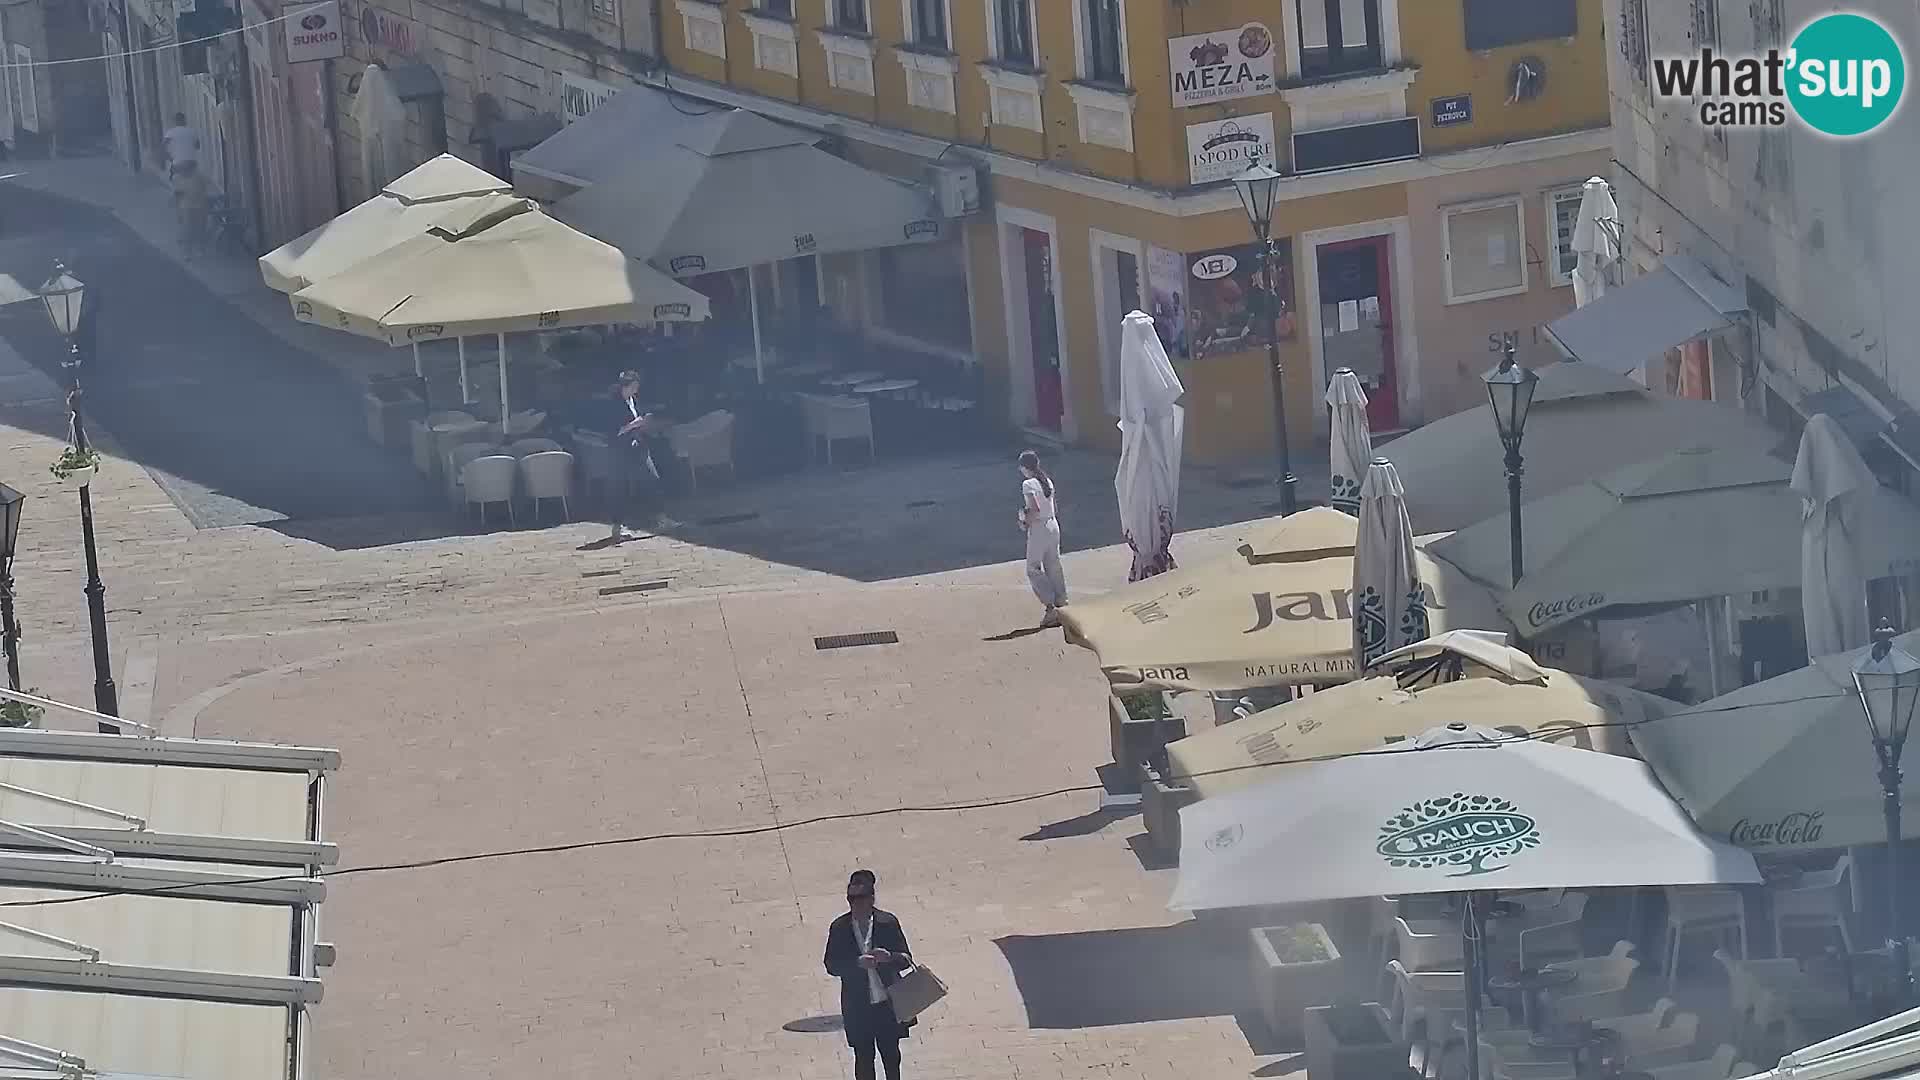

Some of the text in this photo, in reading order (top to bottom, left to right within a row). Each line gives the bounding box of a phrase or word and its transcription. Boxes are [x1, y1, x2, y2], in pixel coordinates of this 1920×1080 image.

[293, 31, 338, 46] SUKNO
[1175, 62, 1254, 93] MEZA
[1184, 89, 1217, 100] PIZZERIA
[1224, 84, 1246, 96] GRILL
[1194, 147, 1239, 166] ISPOD
[1244, 659, 1356, 678] NATURAL MIN
[1417, 818, 1517, 849] RAUCH
